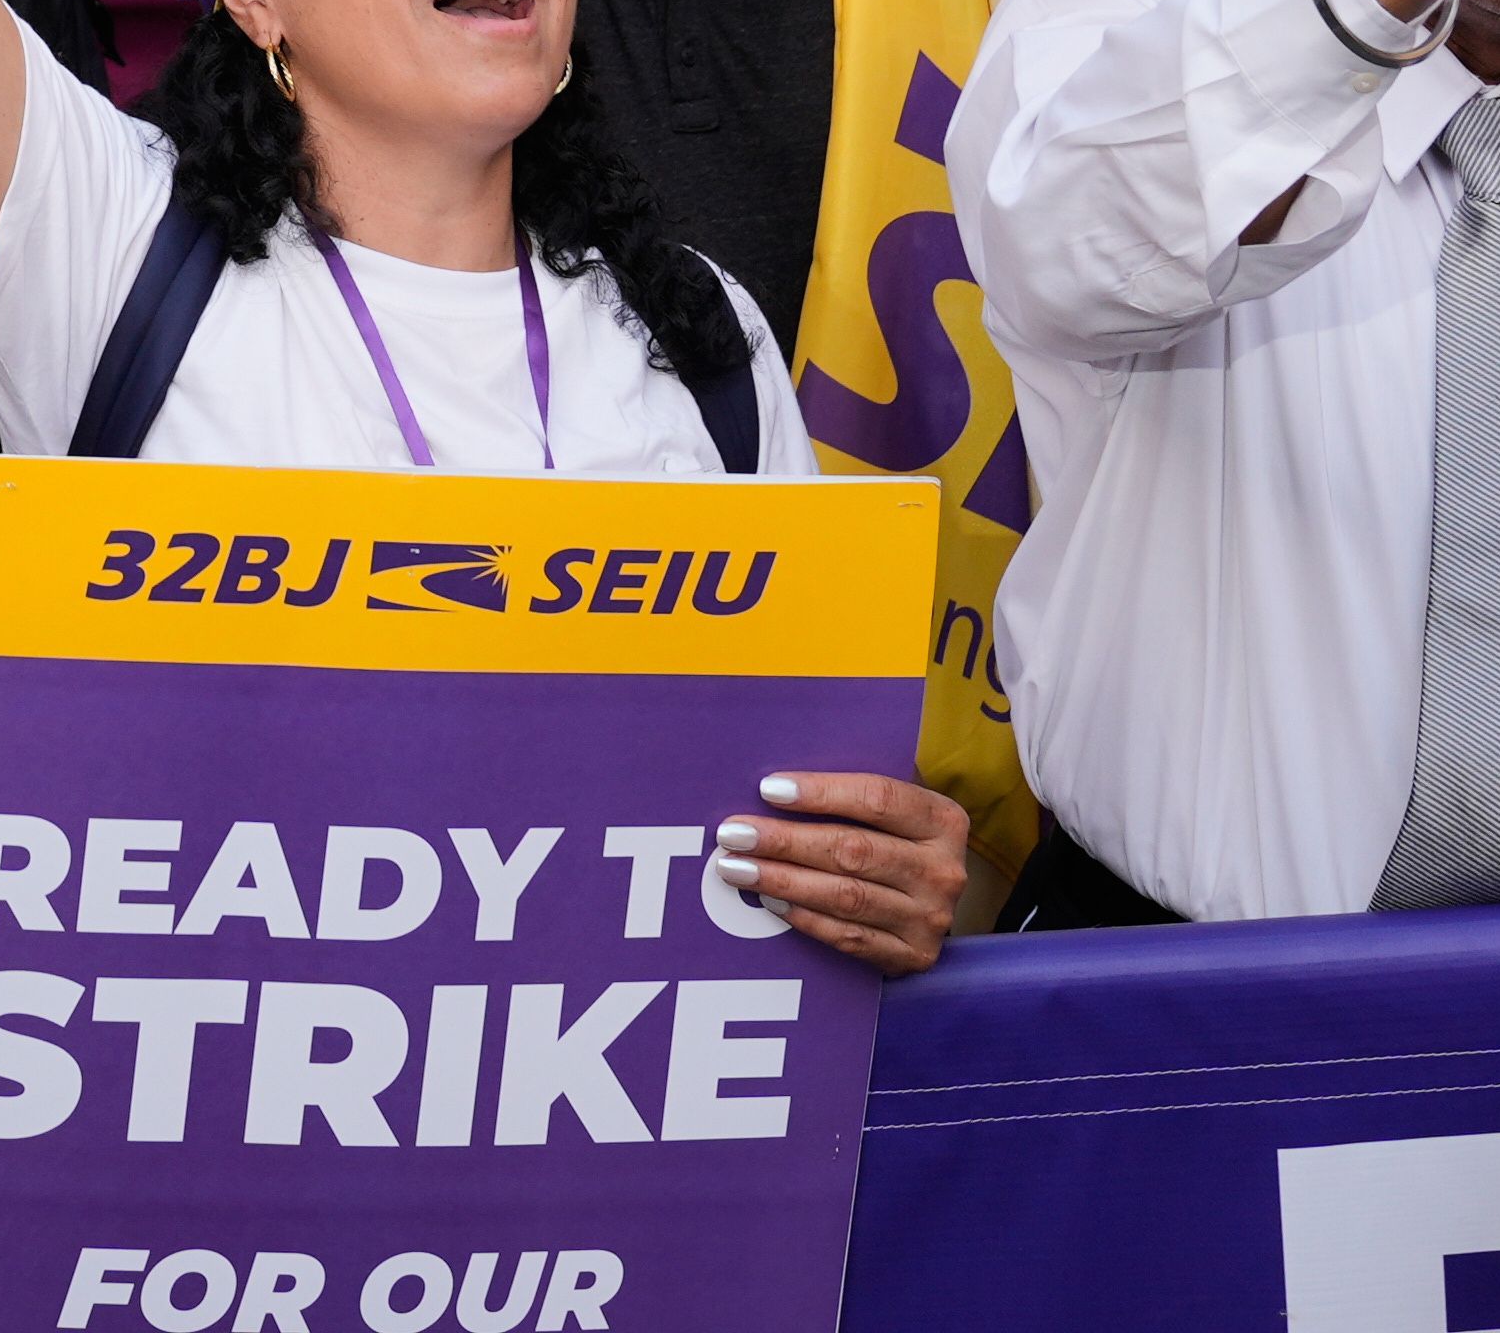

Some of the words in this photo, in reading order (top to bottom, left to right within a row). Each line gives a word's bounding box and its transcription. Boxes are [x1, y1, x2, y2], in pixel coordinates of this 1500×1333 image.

[85, 529, 352, 609] 32BJ
[528, 546, 778, 617] SEIU
[55, 1247, 326, 1333] FOR
[359, 1248, 626, 1332] OUR
